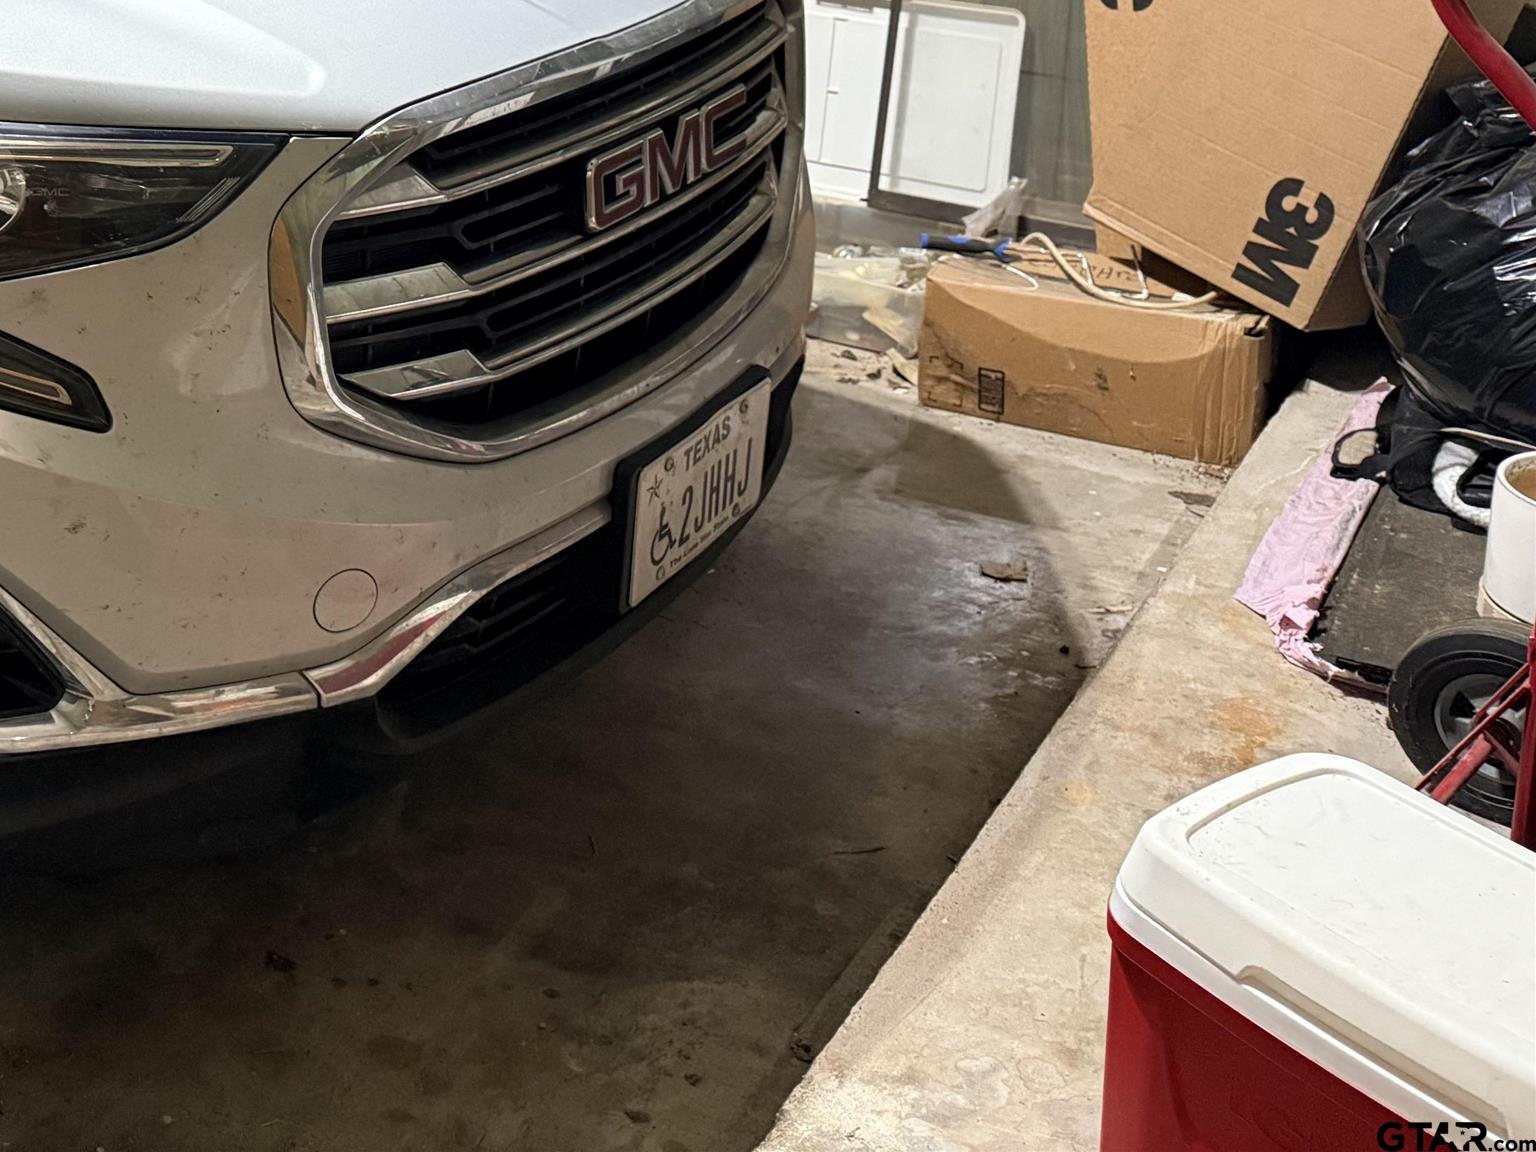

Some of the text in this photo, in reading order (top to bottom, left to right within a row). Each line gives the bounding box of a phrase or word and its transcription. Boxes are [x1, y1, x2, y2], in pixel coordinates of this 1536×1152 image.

[586, 82, 747, 232] GMC
[1231, 177, 1335, 308] 3M
[678, 437, 753, 548] 2JHHJ
[683, 415, 732, 472] TEXAS
